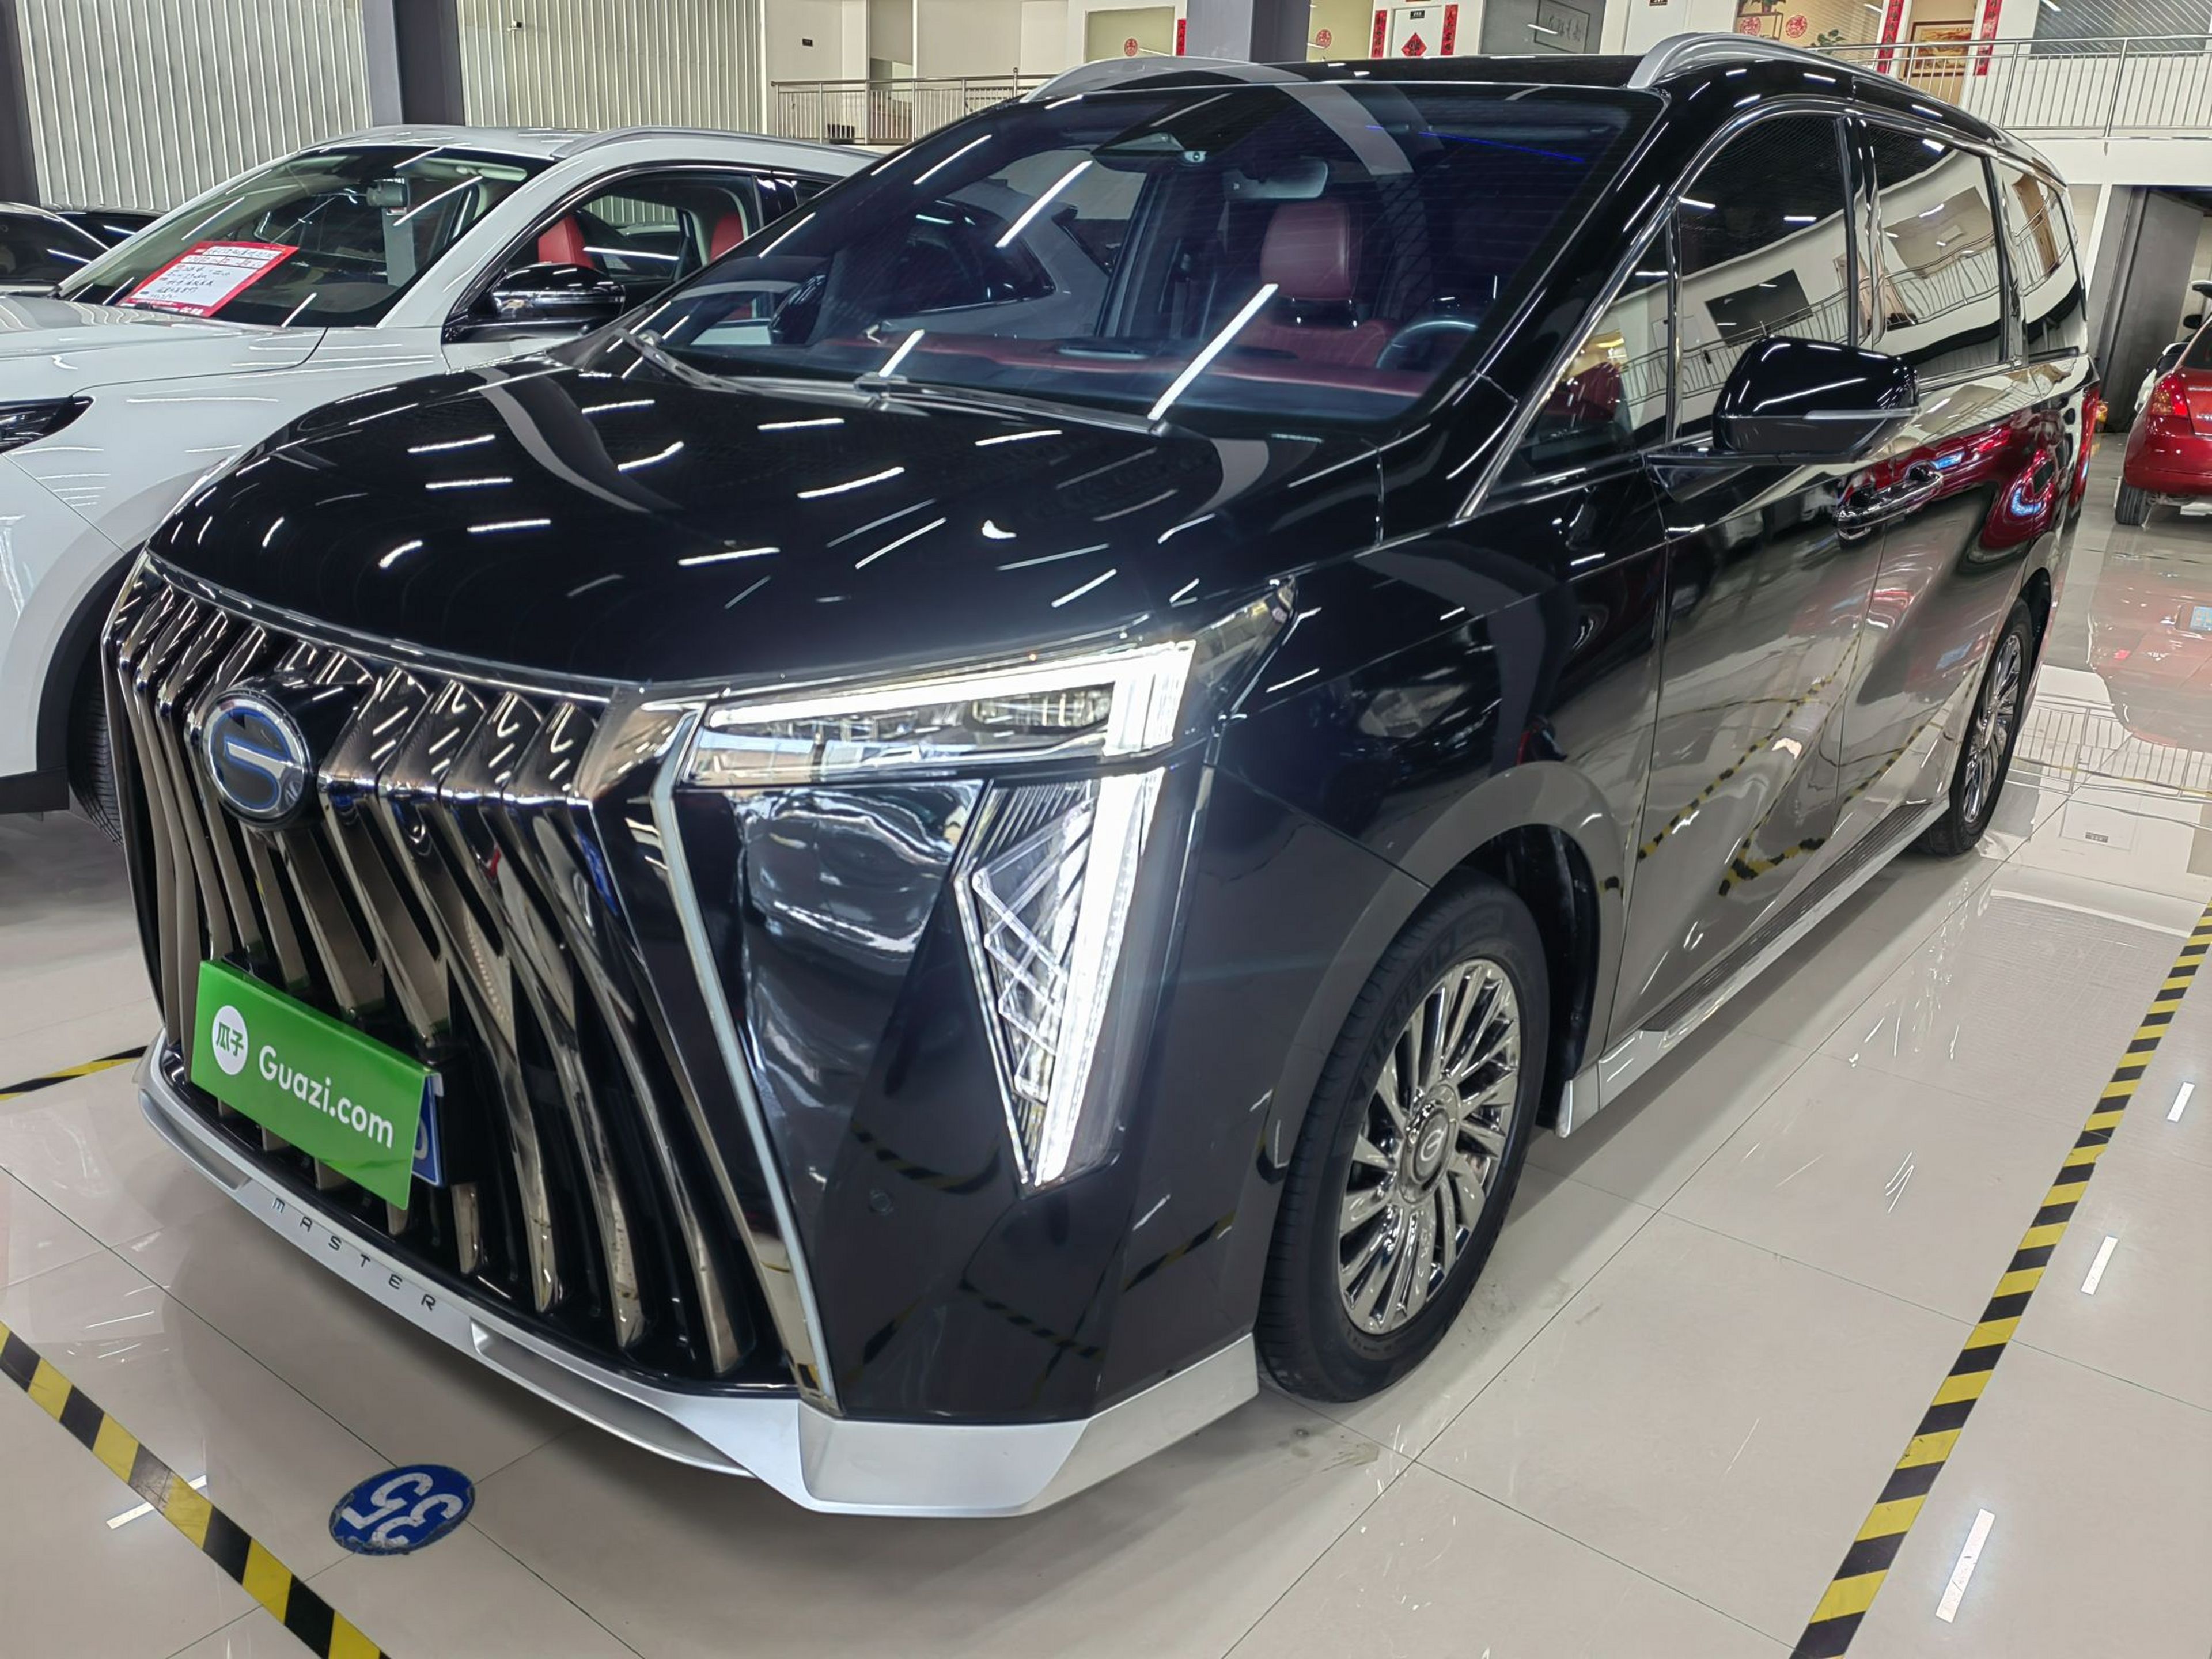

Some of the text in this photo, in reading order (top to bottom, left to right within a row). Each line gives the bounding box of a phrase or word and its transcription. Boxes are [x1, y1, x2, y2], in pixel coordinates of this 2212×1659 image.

[215, 1021, 244, 1056] 瓜子
[259, 1045, 393, 1149] Guazi.com
[271, 1197, 436, 1312] MASTER
[342, 1472, 463, 1548] 35
